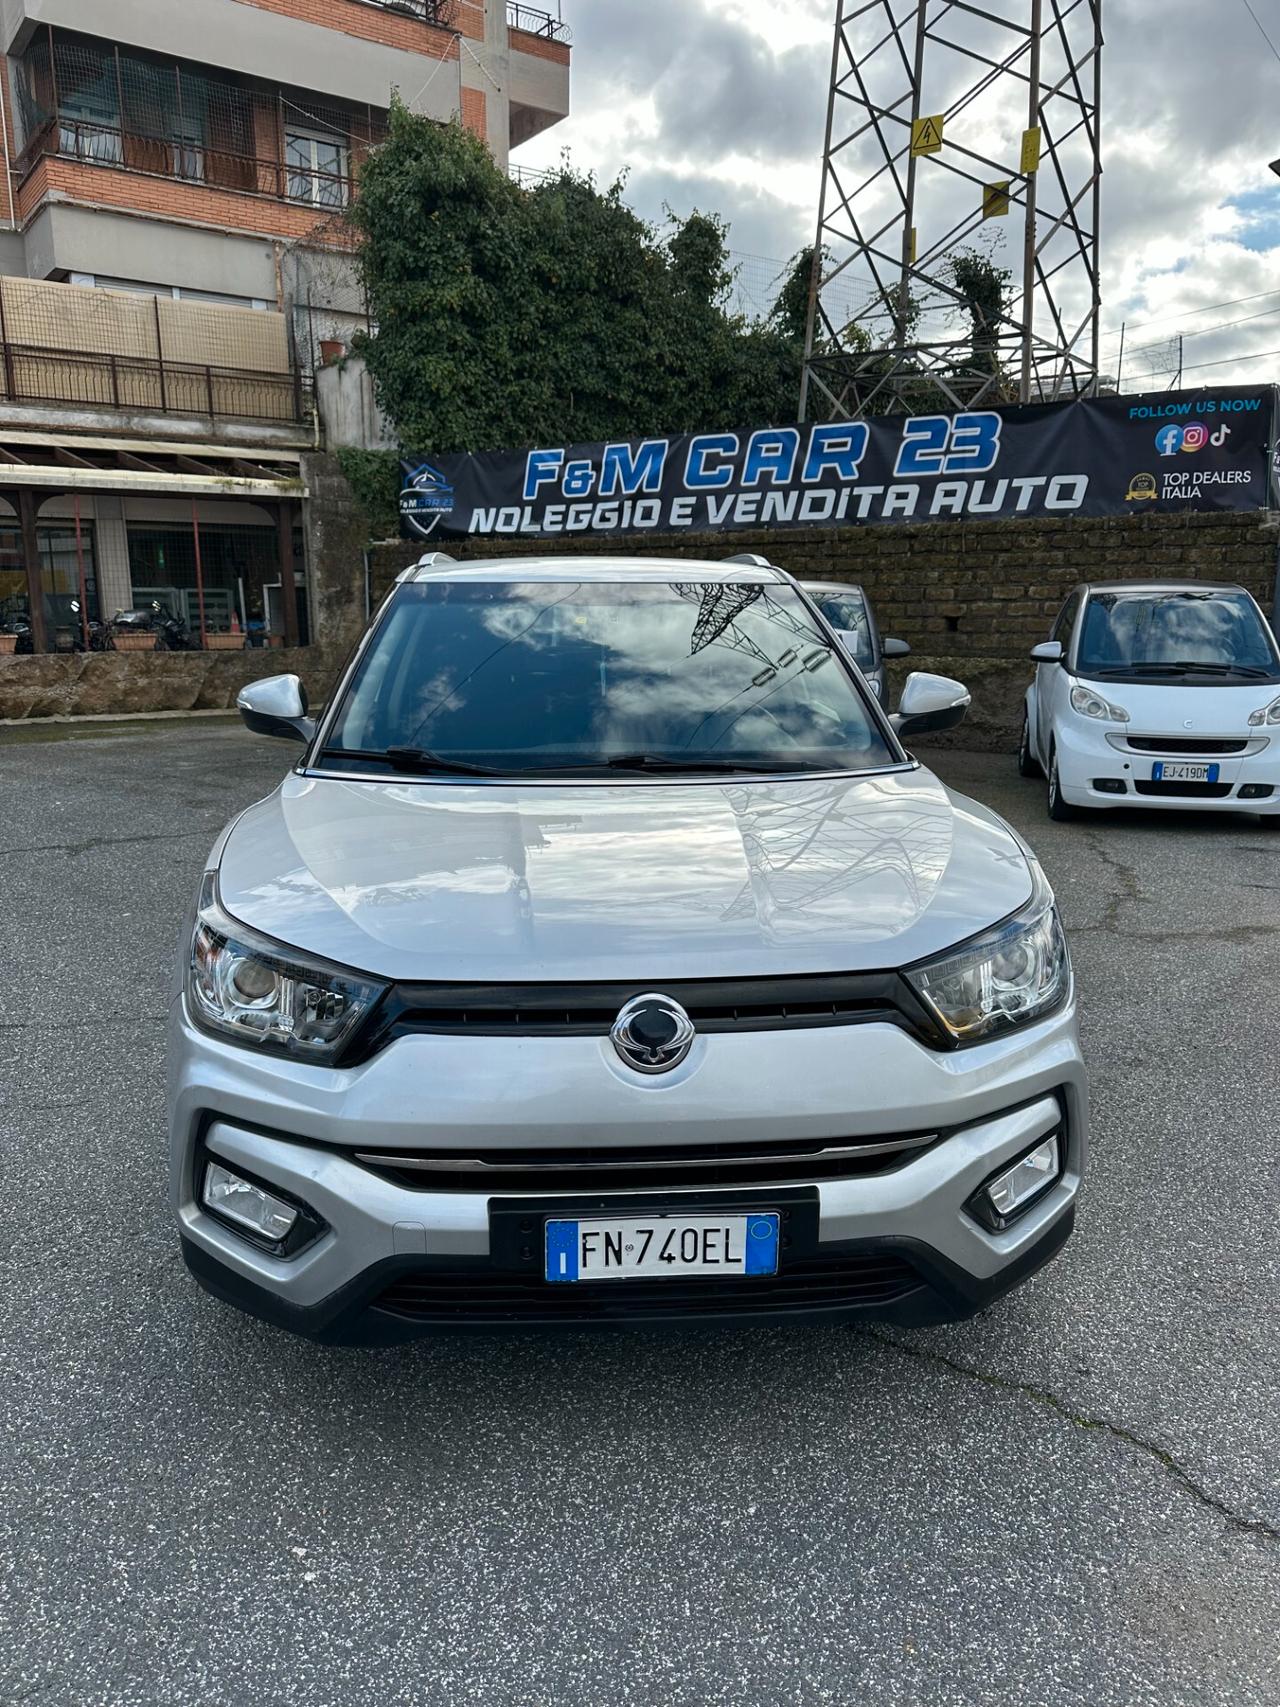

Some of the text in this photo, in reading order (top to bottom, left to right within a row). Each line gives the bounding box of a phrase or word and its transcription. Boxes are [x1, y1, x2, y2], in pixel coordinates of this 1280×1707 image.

[1129, 399, 1261, 418] FOLLOW US NOW
[523, 411, 1002, 500] F&M CAR 23
[1163, 470, 1251, 486] TOP DEALERS
[1162, 486, 1202, 499] ITALIA
[468, 474, 1089, 533] NOLEGGIO E VENDITA AUTO
